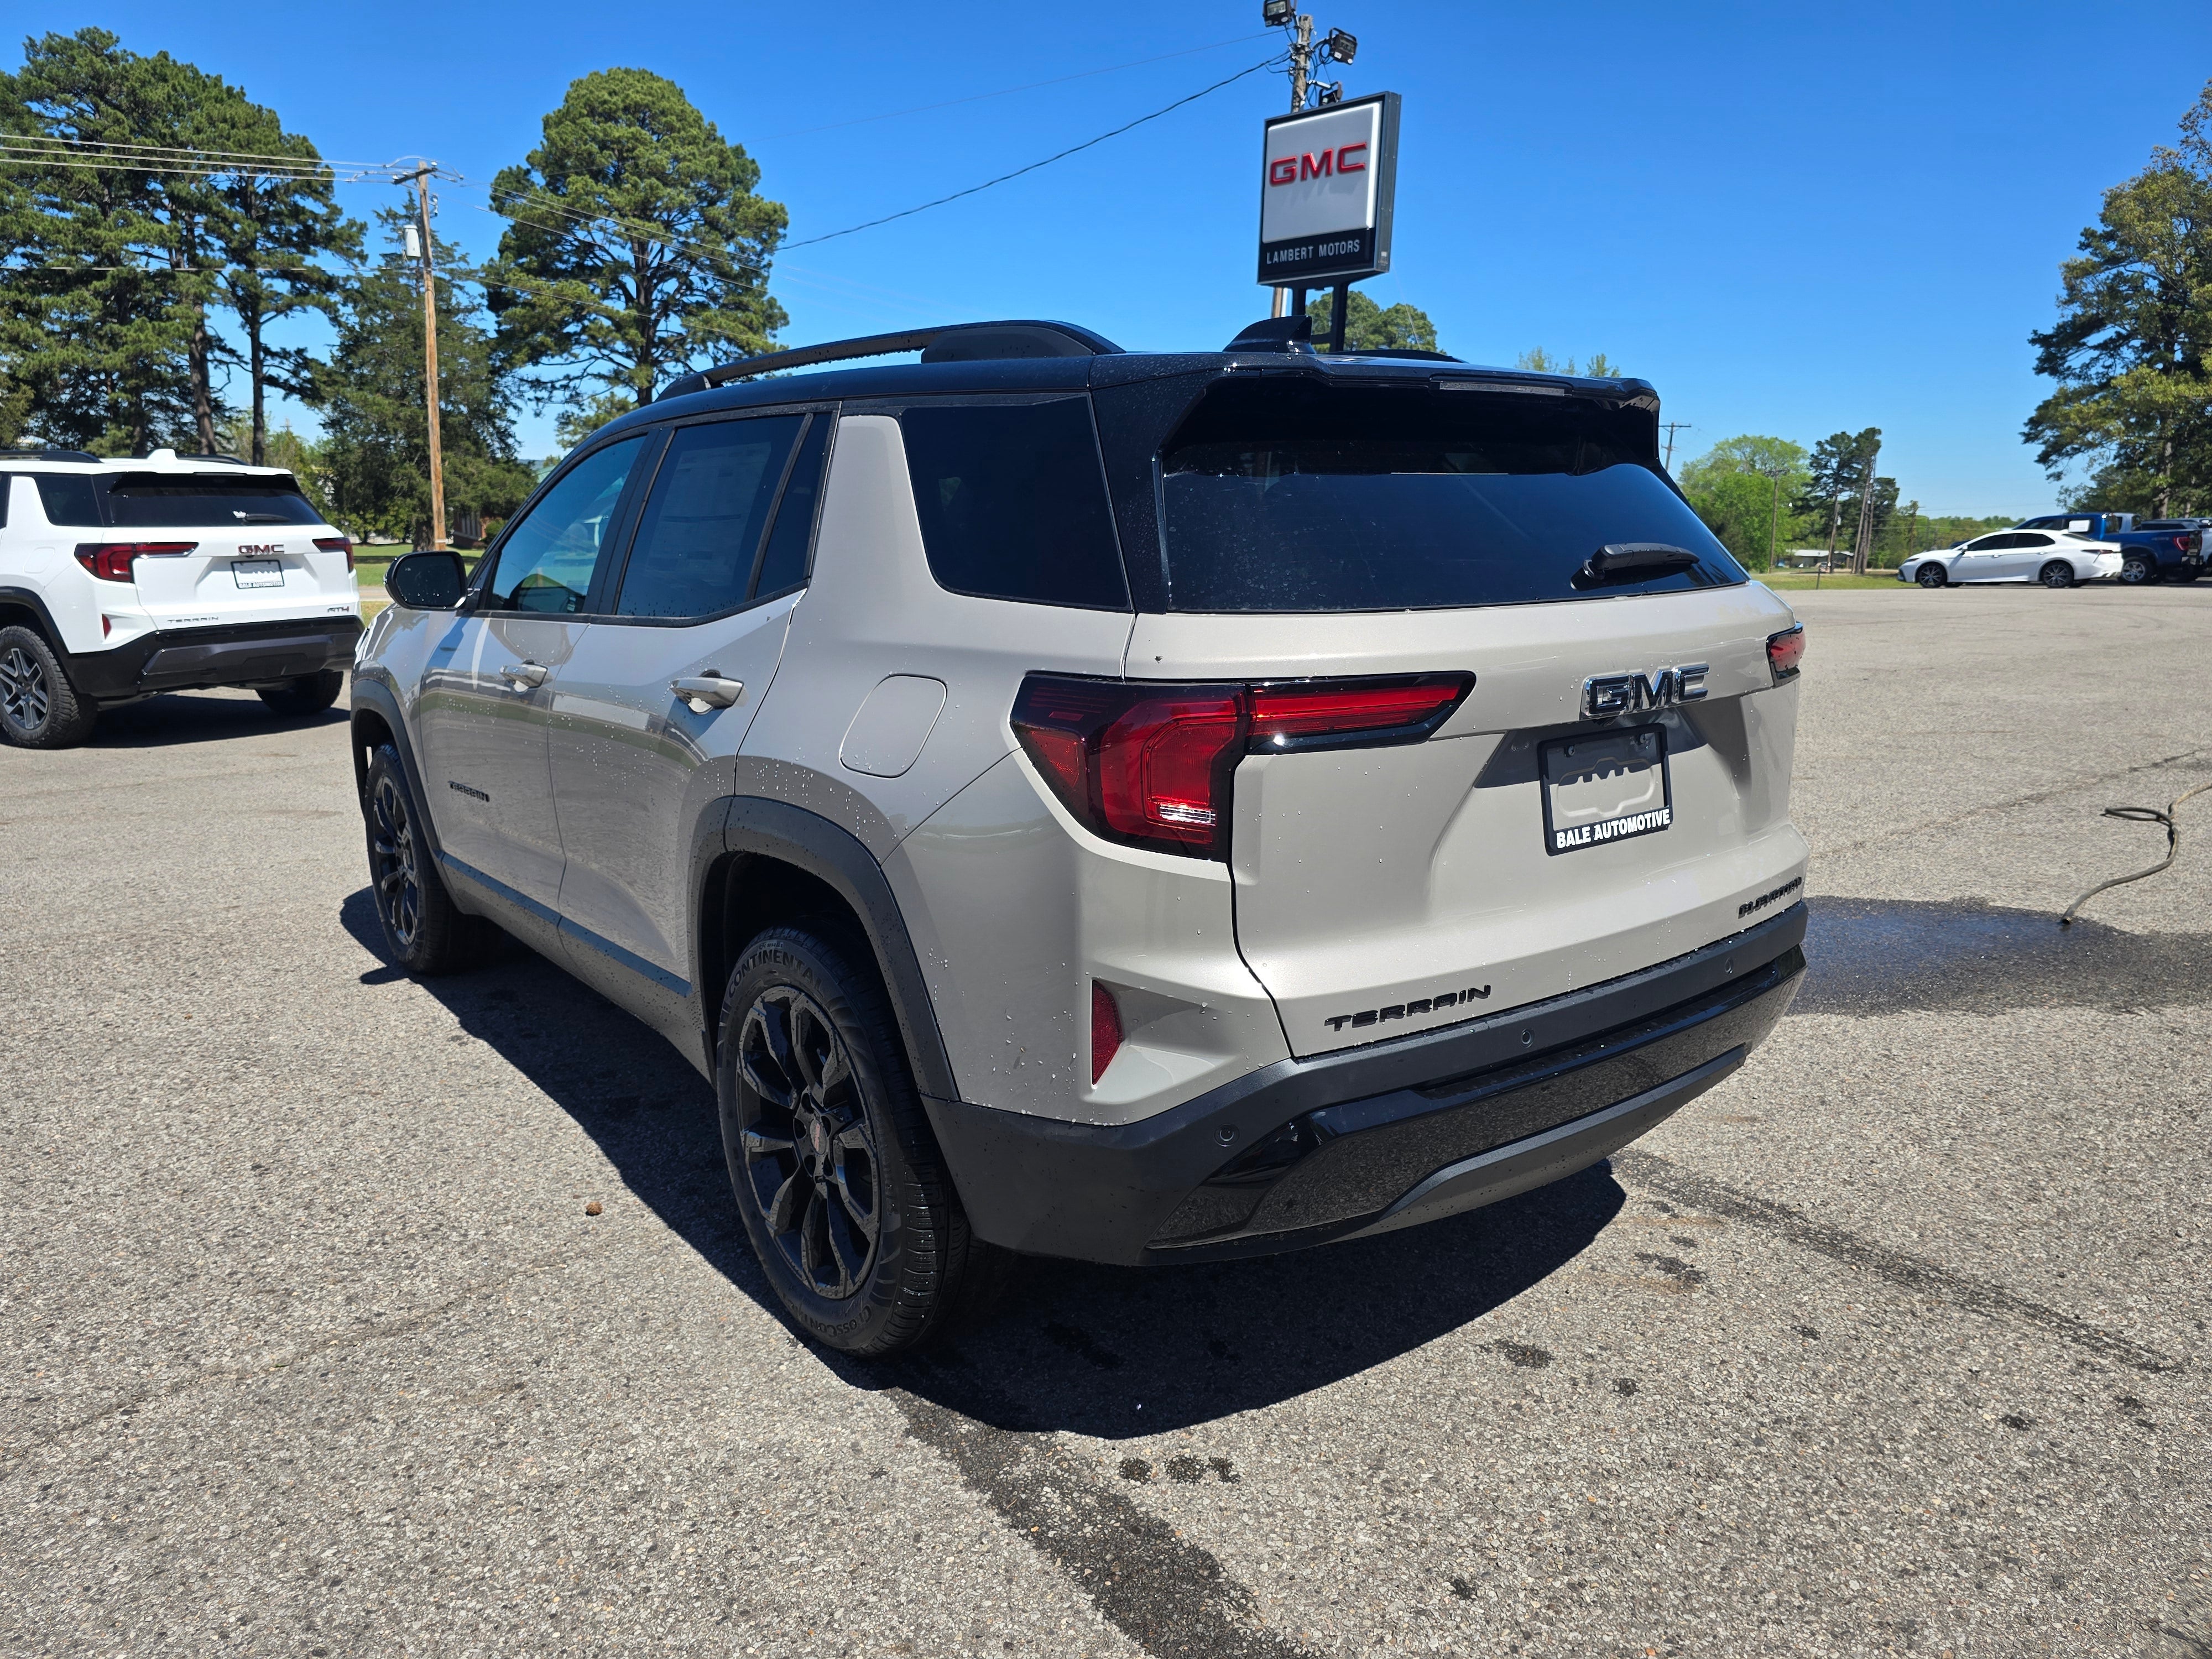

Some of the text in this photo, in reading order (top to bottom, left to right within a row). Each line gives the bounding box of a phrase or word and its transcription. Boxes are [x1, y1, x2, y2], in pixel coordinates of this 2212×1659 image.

[1270, 142, 1367, 187] GMC
[1266, 239, 1360, 264] LAMBERT MOTORS
[238, 544, 285, 555] GMC
[1582, 664, 1709, 717] GMC
[1556, 808, 1671, 849] BALE AUTOMOTIVE
[728, 949, 824, 999] CONTINENTAL
[1324, 984, 1491, 1032] TERRAIN
